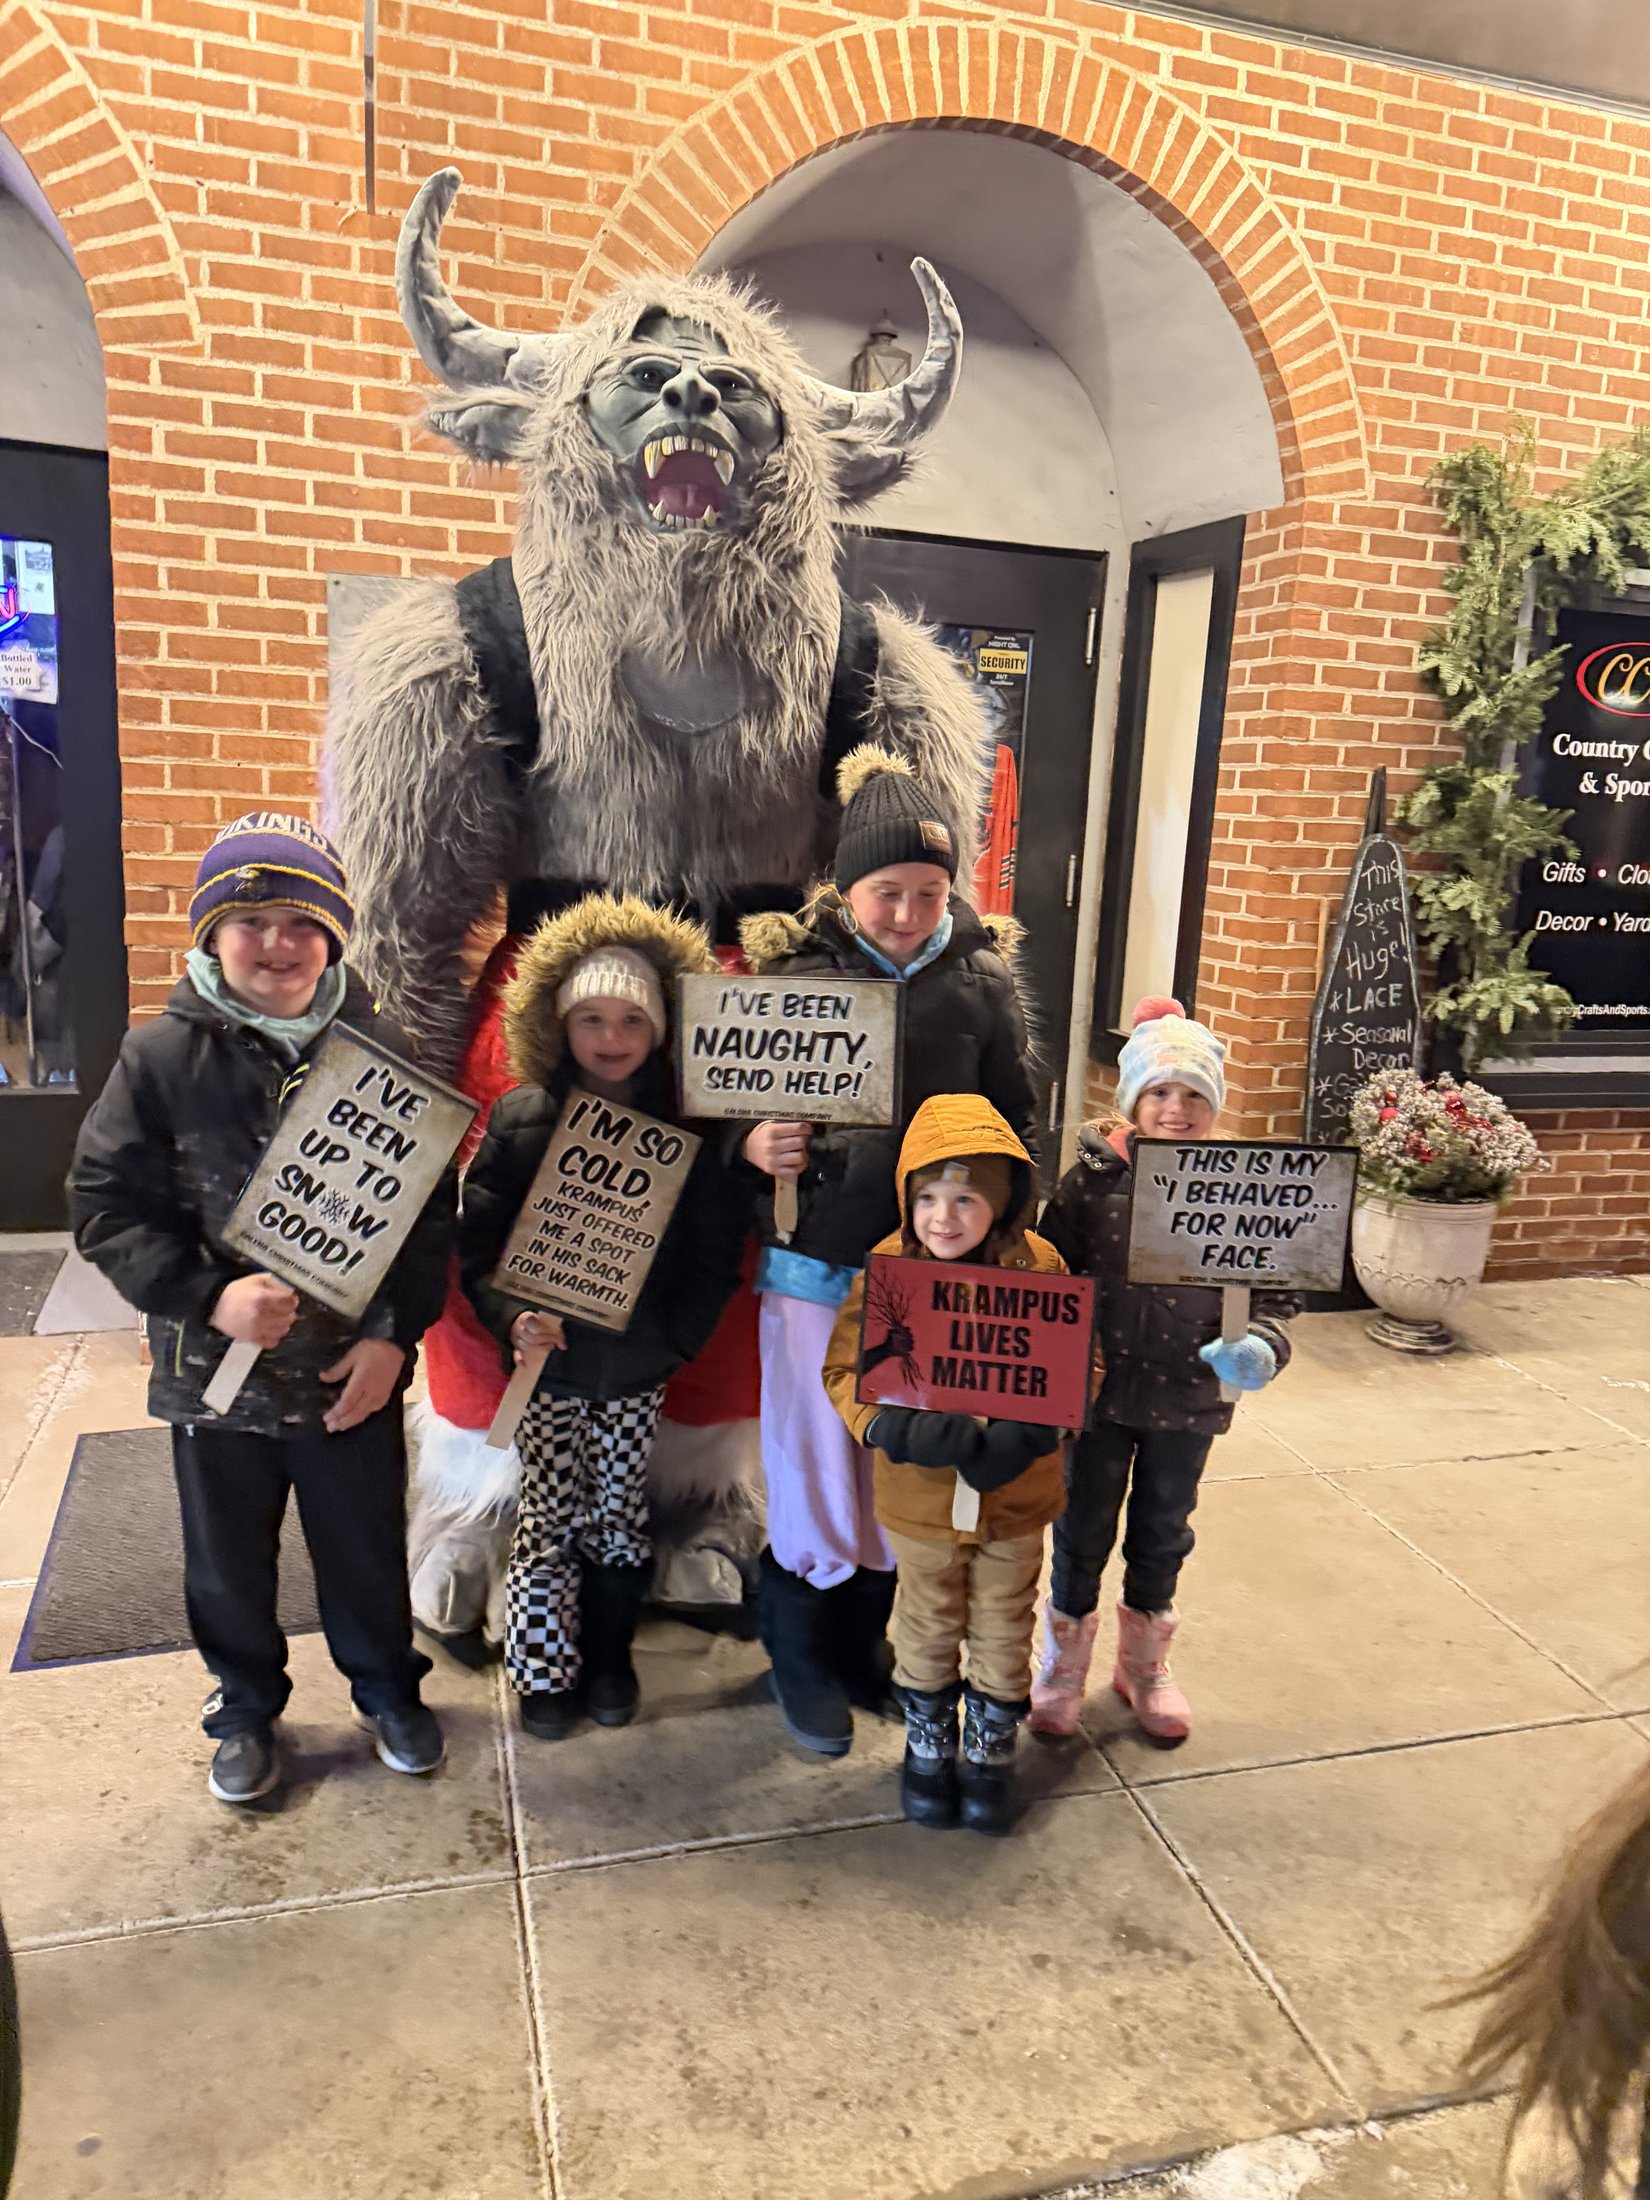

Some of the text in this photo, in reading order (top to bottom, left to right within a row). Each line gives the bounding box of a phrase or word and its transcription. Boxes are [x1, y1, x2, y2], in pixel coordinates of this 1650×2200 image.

[0, 654, 33, 663] Bottled
[4, 664, 32, 674] Water
[980, 656, 1026, 670] SECURITY
[2, 677, 32, 686] $1.00
[1552, 733, 1639, 767] Country
[1579, 772, 1600, 794] &
[215, 811, 328, 850] IKING
[1361, 860, 1400, 891] This
[1543, 862, 1586, 883] Gifts
[1354, 898, 1402, 927] Store
[1536, 910, 1594, 932] Decor
[1370, 920, 1390, 941] is
[1346, 922, 1408, 981] Huge!
[720, 988, 854, 1020] I'VE BEEN
[1346, 983, 1403, 1014] LACE
[1339, 1018, 1412, 1045] Seasonal
[694, 1026, 874, 1070] NAUGHTY,
[1352, 1047, 1410, 1070] Decor
[355, 1066, 429, 1121] I'VE
[706, 1066, 863, 1098] SEND HELP!
[328, 1098, 418, 1163] BEEN
[567, 1099, 684, 1167] I'M SO
[300, 1128, 401, 1201] UP TO
[558, 1145, 652, 1209] COLD,
[1176, 1148, 1328, 1178] THIS IS MY
[558, 1181, 646, 1224] KRAMPUS
[1186, 1180, 1338, 1210] BEHAVED...
[258, 1201, 365, 1275] GOOD!
[534, 1196, 656, 1249] JUST OFFERED
[1170, 1211, 1318, 1240] FOR NOW"
[539, 1220, 635, 1264] ME A SPOT
[1201, 1244, 1277, 1270] FACE.
[528, 1239, 632, 1286] IN HIS SACK
[508, 1254, 546, 1279] FOR
[548, 1268, 628, 1310] WARMTH.
[931, 1280, 1081, 1325] KRAMPUS
[950, 1320, 1032, 1358] LIVES
[931, 1356, 1049, 1398] MATTER
